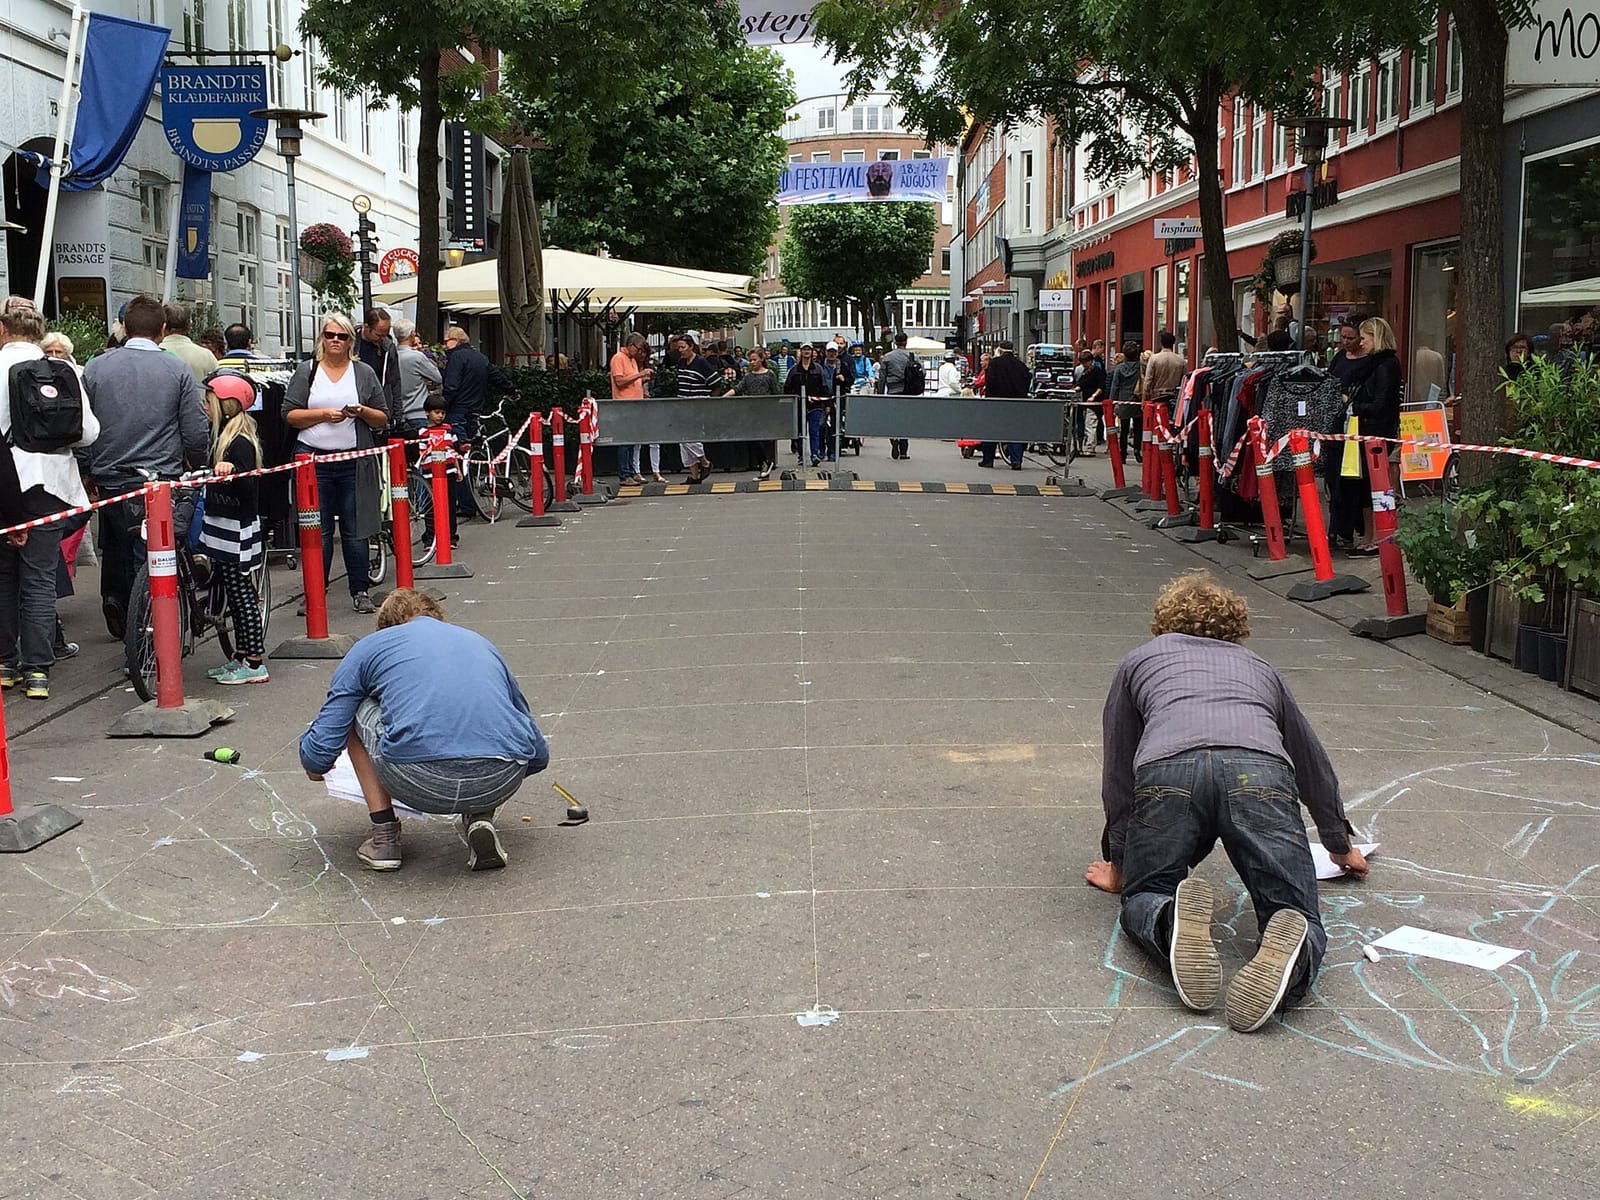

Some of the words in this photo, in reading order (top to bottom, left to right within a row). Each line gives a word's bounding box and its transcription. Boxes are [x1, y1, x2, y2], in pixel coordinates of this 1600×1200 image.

[168, 74, 262, 90] BRANDTS
[168, 92, 263, 103] KLÆDEFABRIK
[167, 127, 220, 169] BRANDTS
[223, 127, 267, 169] PASSAGE
[796, 166, 865, 191] FESTIVAL
[900, 174, 938, 188] AUGUST
[55, 243, 106, 253] BRANDTS
[57, 253, 105, 264] PASSAGE
[388, 249, 420, 267] CUCKO
